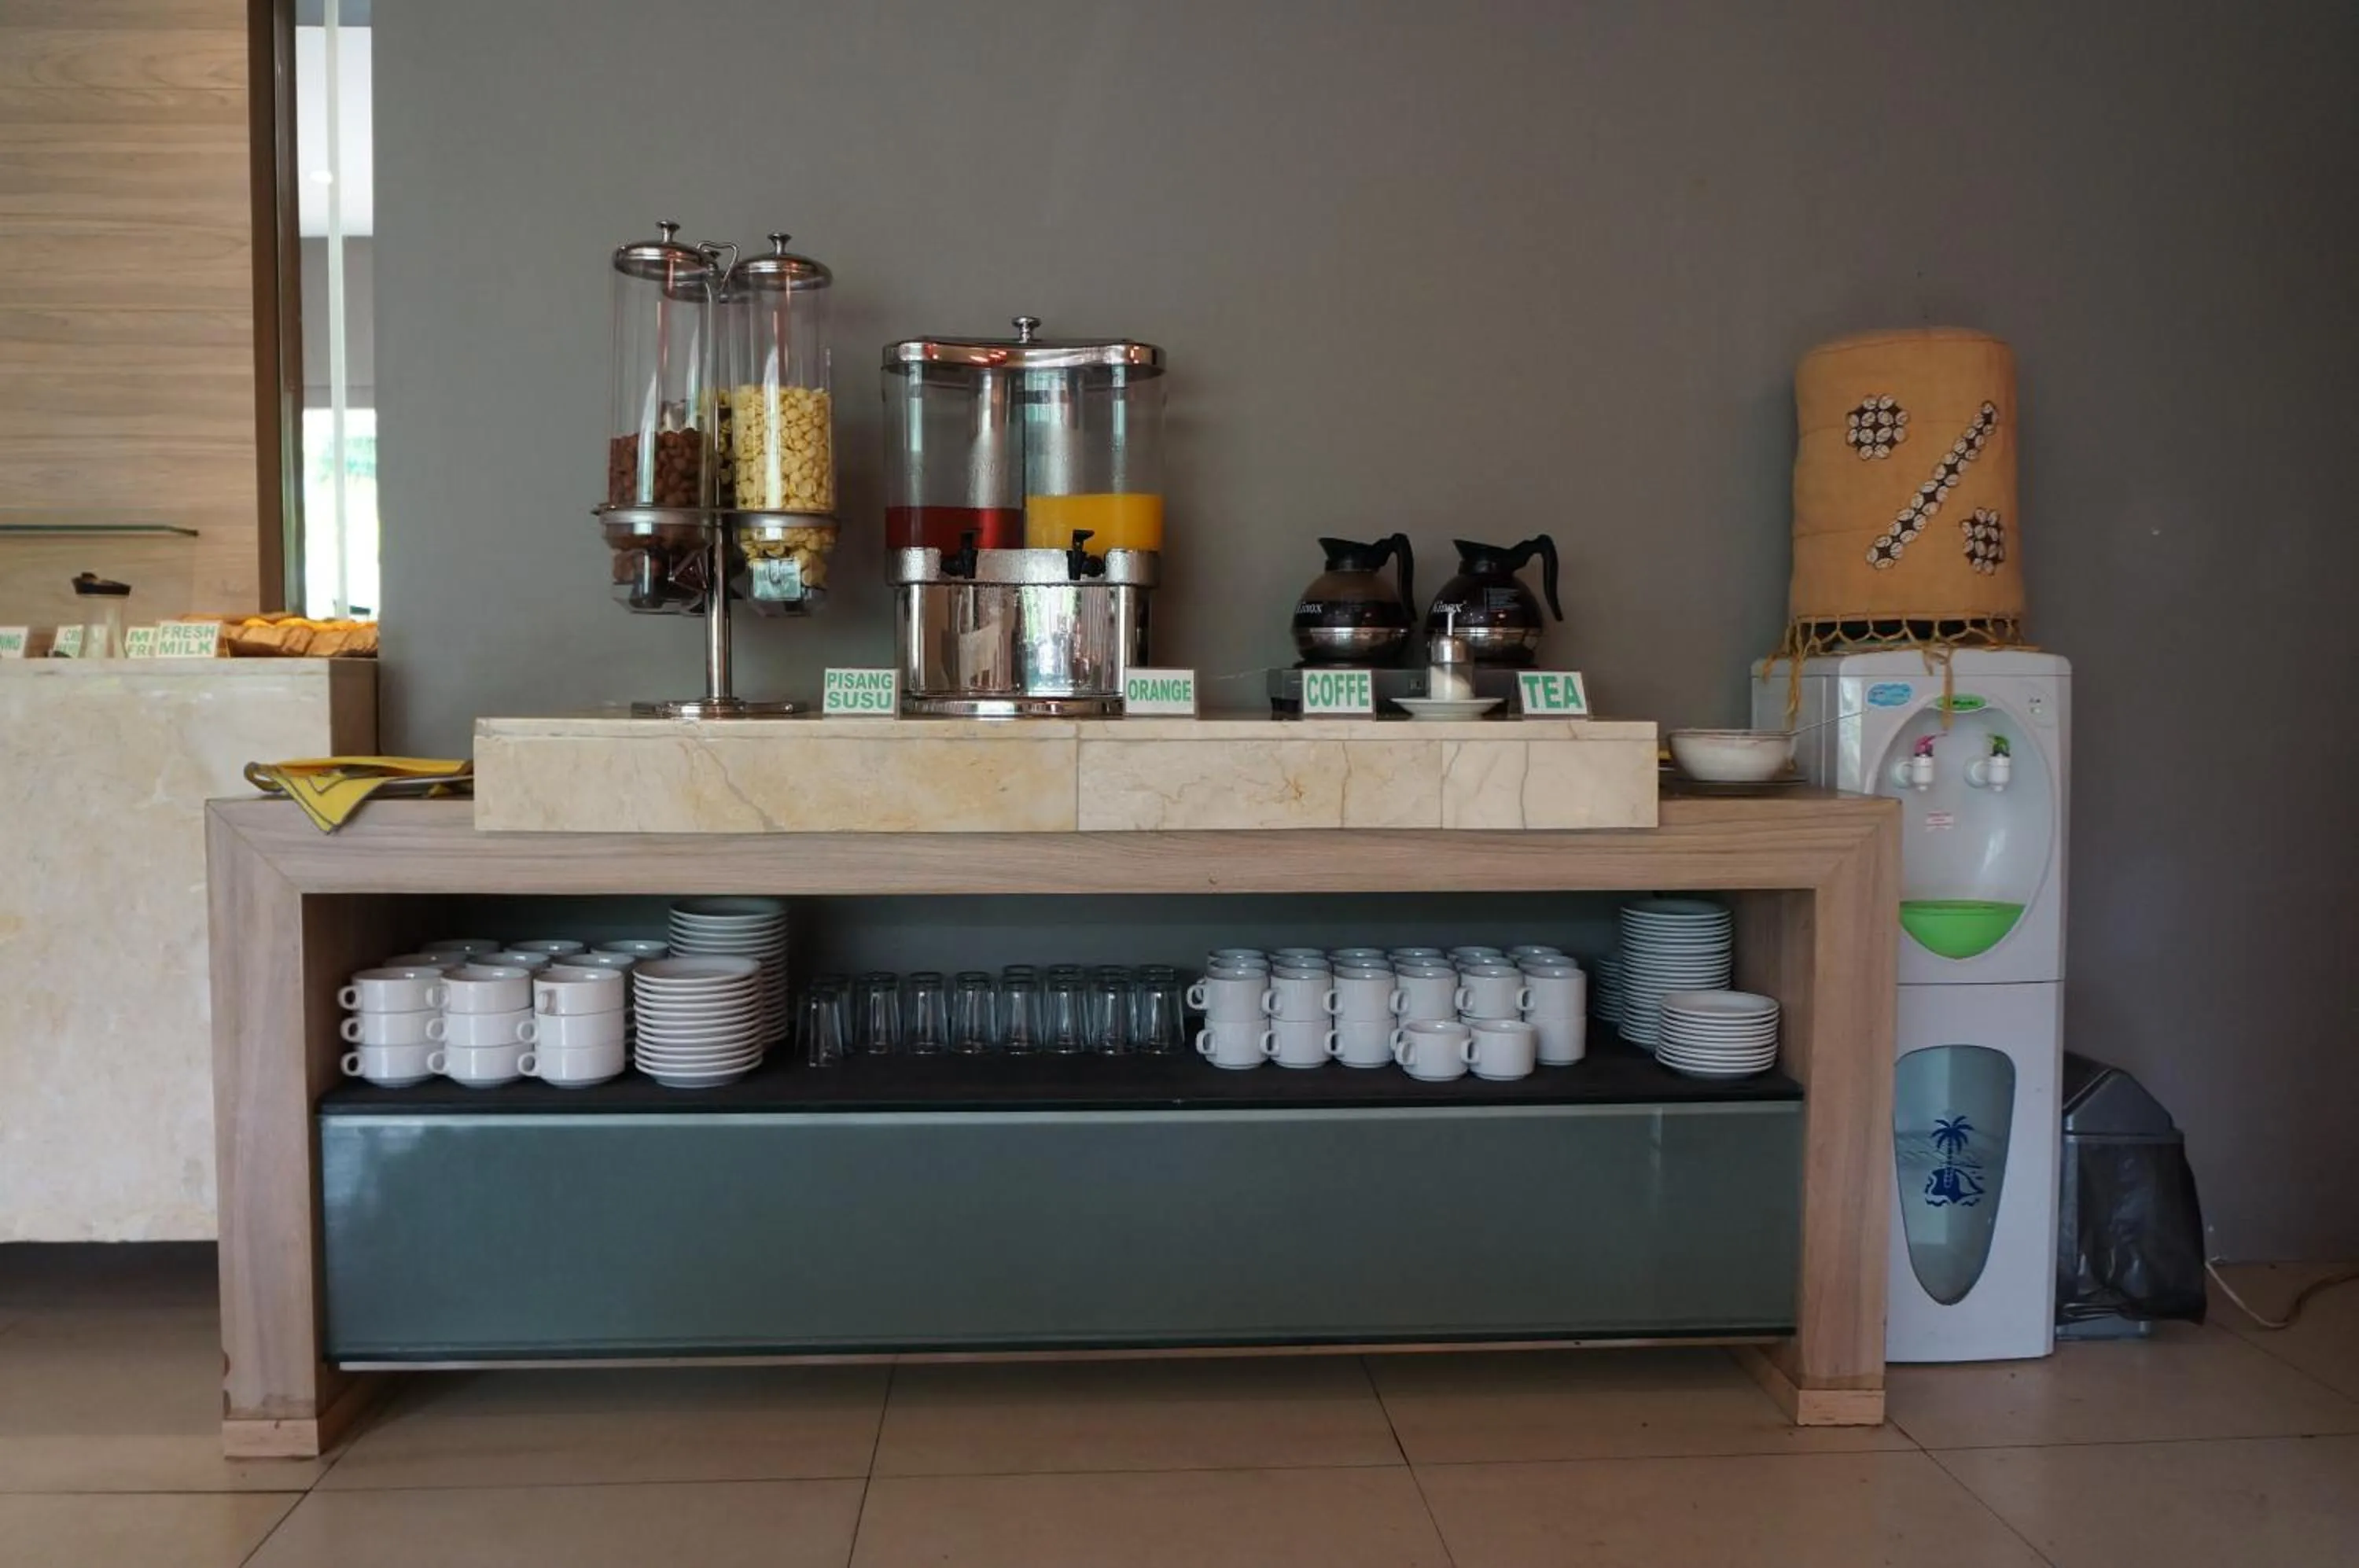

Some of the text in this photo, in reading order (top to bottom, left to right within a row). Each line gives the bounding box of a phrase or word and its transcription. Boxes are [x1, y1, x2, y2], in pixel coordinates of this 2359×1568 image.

[161, 625, 215, 640] FRESH
[159, 641, 212, 655] MILK
[826, 672, 893, 690] PISANG
[1307, 673, 1369, 707] COFFE
[1128, 679, 1191, 702] ORANGE
[1522, 675, 1583, 709] TEA
[827, 691, 892, 709] SUSU
